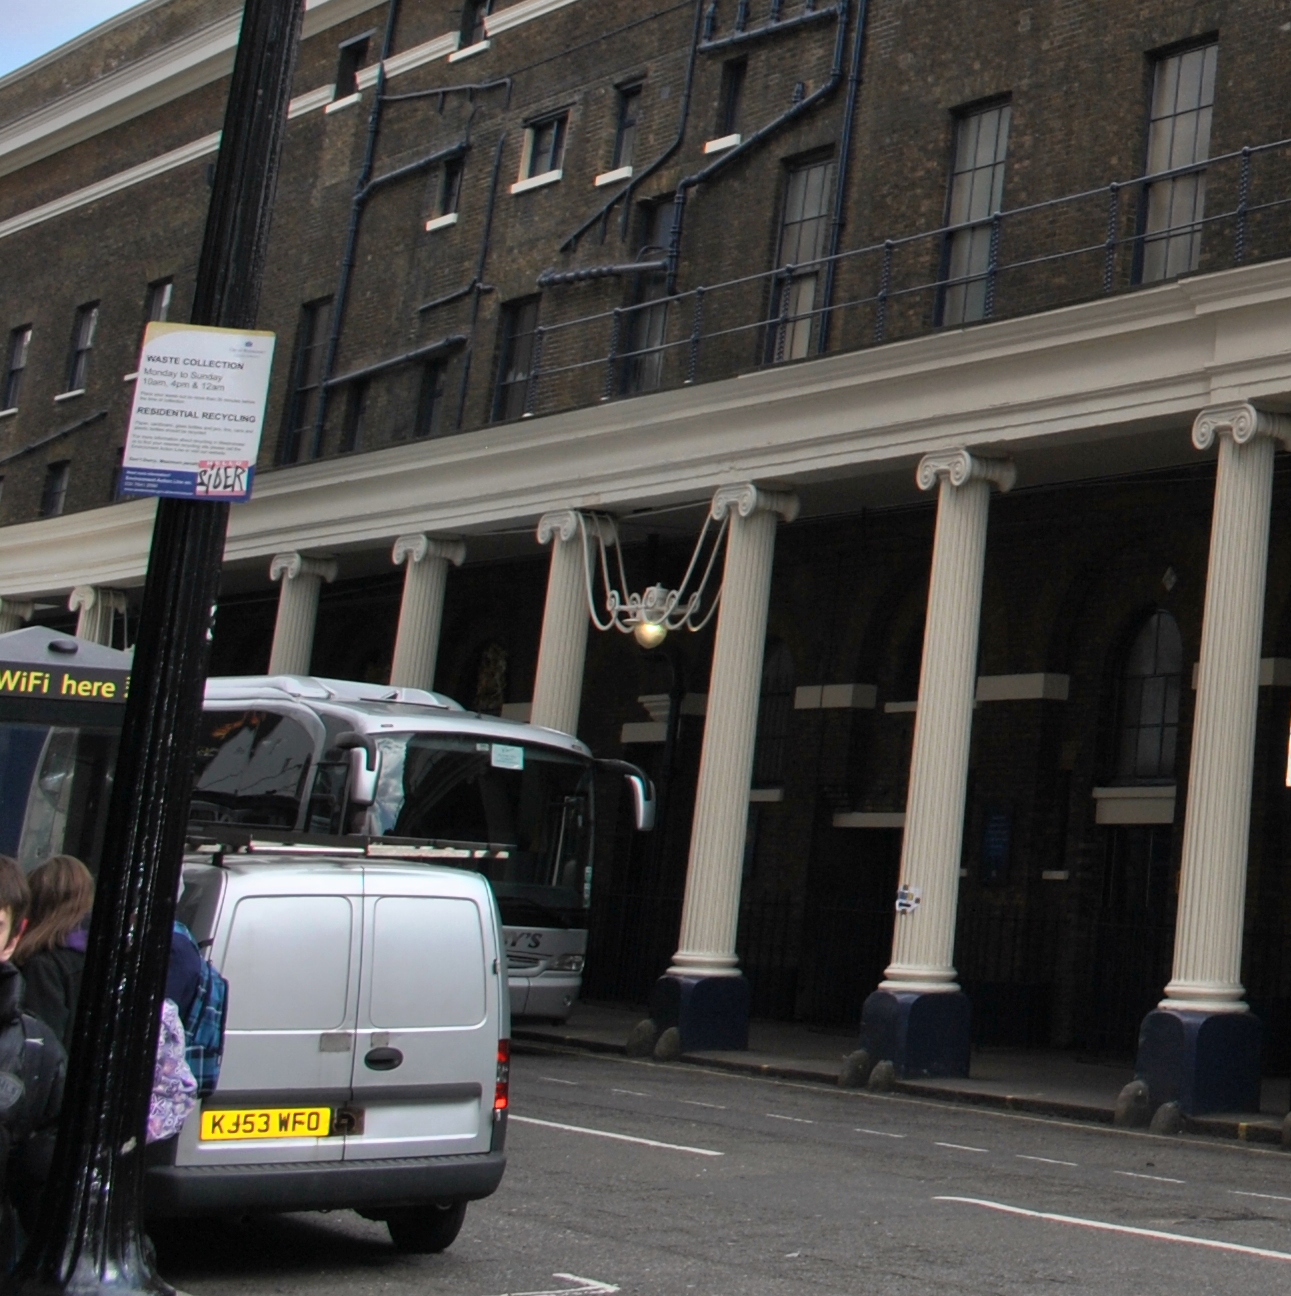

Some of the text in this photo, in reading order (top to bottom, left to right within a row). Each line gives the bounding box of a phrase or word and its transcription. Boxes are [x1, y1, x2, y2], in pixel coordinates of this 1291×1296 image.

[146, 354, 245, 370] WASTE COLLECTION
[144, 367, 223, 382] Monday to Sunday
[136, 406, 256, 423] RESIDENTIAL RECYCLING
[61, 673, 116, 698] here
[211, 1112, 271, 1135] KJ53
